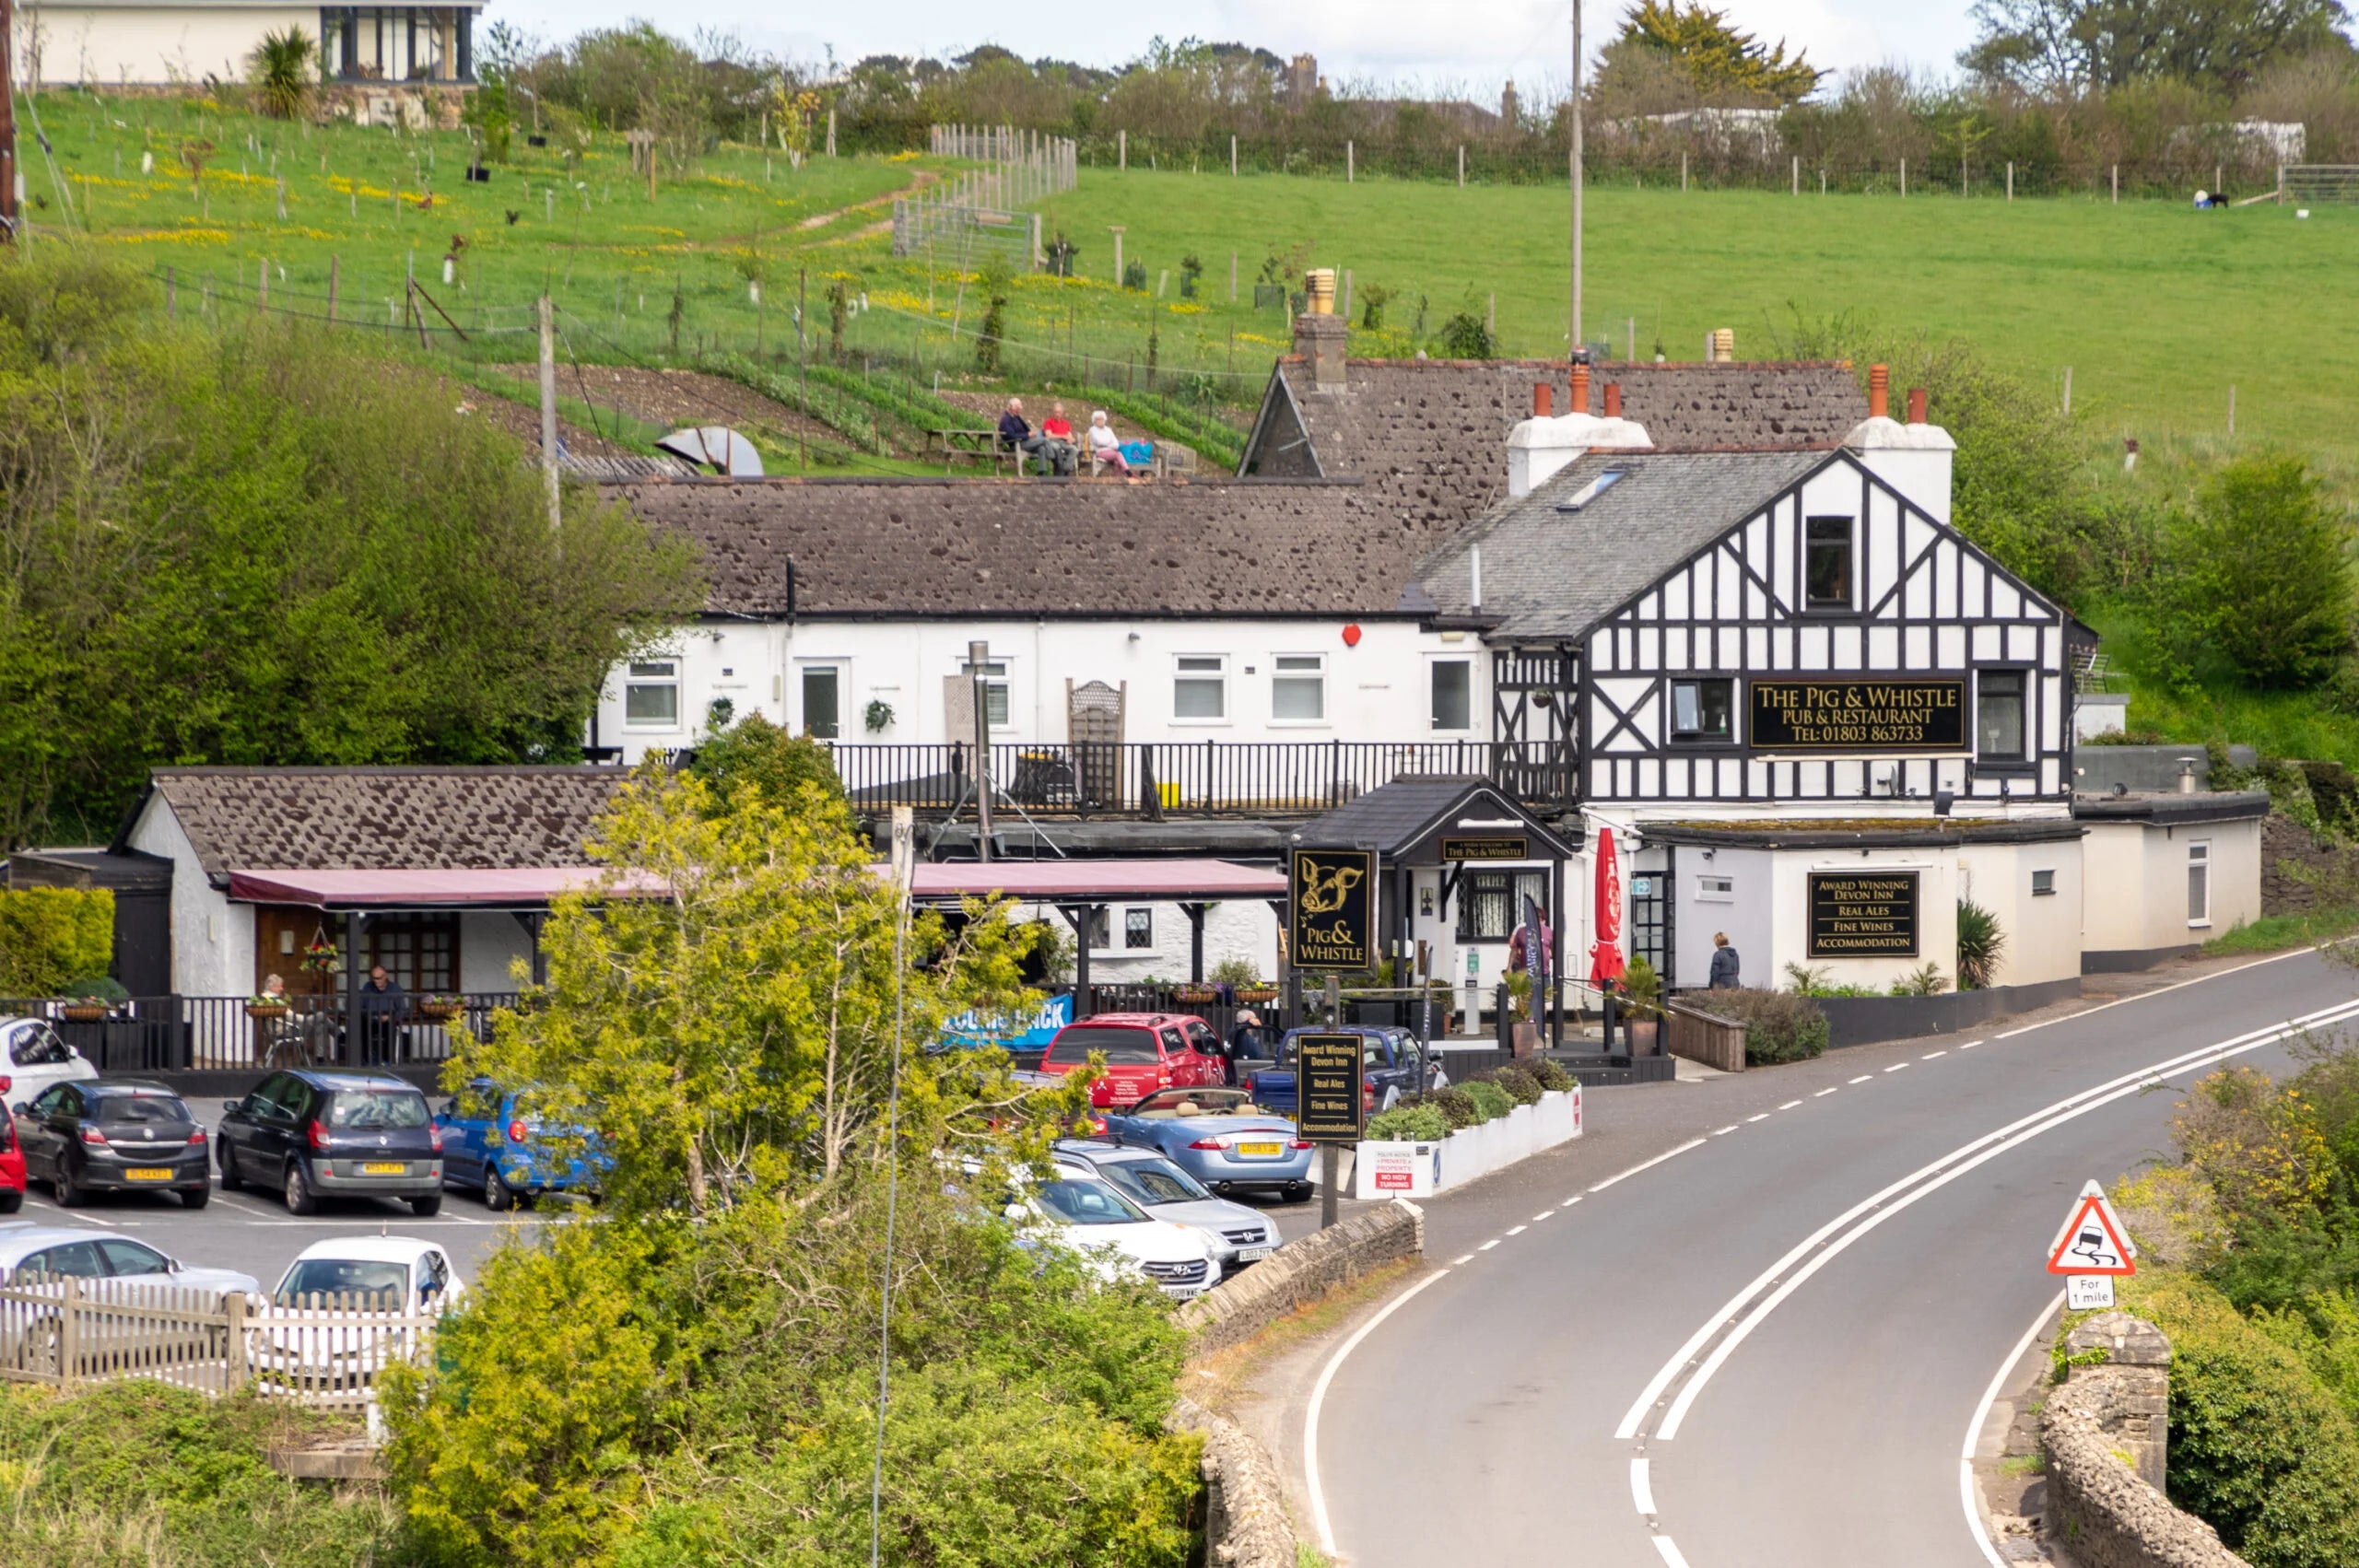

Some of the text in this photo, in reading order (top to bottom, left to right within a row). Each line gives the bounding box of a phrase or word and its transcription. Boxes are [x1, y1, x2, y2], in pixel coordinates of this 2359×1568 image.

[1757, 686, 1956, 708] THE PIG & WHISTLE
[1782, 708, 1933, 725] PUB & RESTAURANT
[1823, 726, 1867, 741] 01803
[1872, 726, 1923, 741] 863733
[1448, 847, 1522, 857] THE PIG & WHISTLE
[1819, 880, 1909, 891] AWARD WINNING
[1834, 890, 1895, 900] DEVON INN
[1838, 906, 1890, 916] REAL ALES
[1834, 921, 1895, 932] FINE WINES
[1815, 938, 1910, 948] ACCOMMODATION
[1299, 944, 1364, 961] WHISTLE
[1302, 1044, 1356, 1057] Award Winning
[1311, 1057, 1348, 1067] Devon Inn
[1313, 1079, 1345, 1088] Real Ales
[1311, 1100, 1348, 1110] Fine Wines
[1302, 1122, 1357, 1132] Accommodation
[2080, 1279, 2100, 1290] For
[2073, 1293, 2108, 1304] 1 mile
